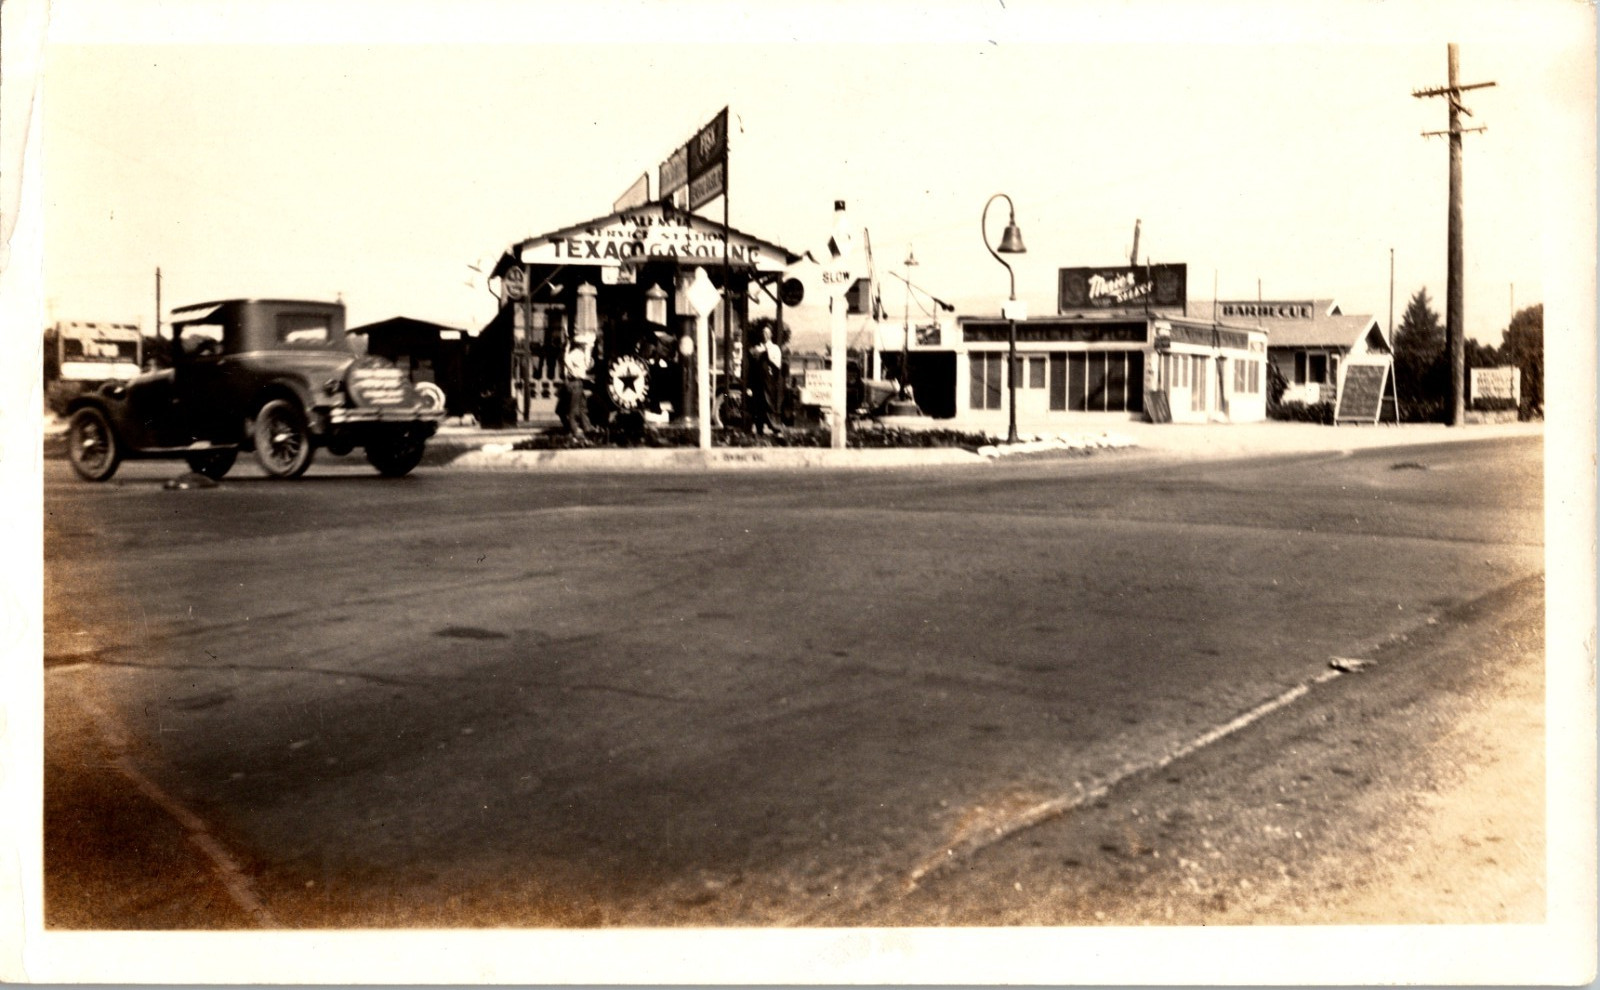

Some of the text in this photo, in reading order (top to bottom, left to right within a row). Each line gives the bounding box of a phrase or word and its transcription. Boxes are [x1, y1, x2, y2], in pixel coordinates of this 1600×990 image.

[550, 238, 760, 264] TEXACO GASOLNE
[822, 271, 850, 285] SLOW
[1223, 305, 1312, 317] BARBECUE
